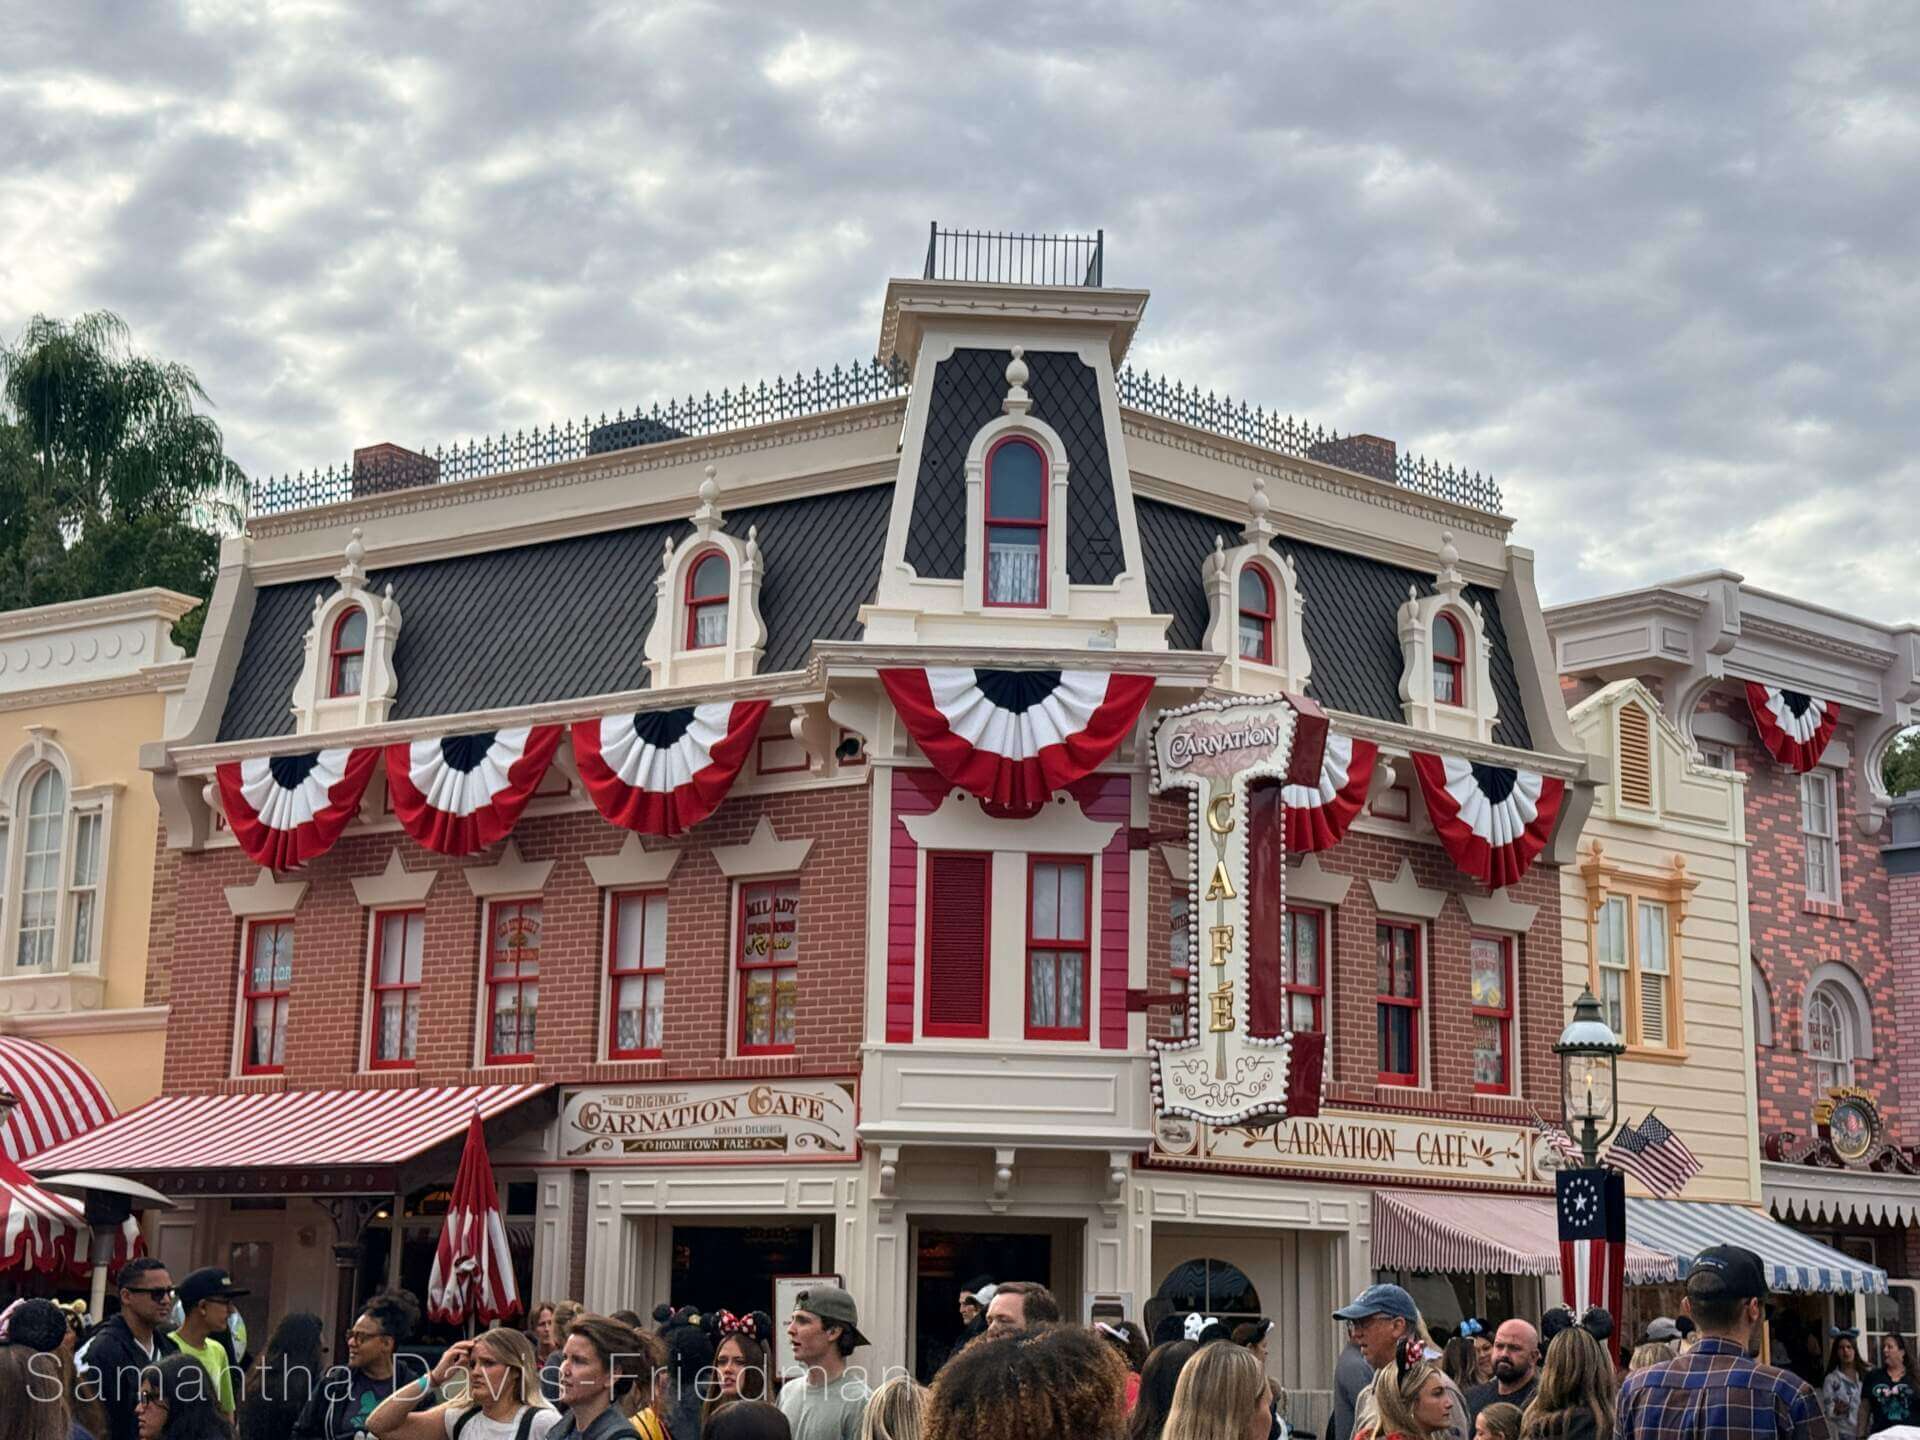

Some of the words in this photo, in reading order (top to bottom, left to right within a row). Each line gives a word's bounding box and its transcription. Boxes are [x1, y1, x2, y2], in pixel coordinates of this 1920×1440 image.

[1166, 725, 1279, 769] CARNATION
[746, 898, 798, 918] MILADY
[1205, 792, 1238, 1034] CAFÉ
[578, 1096, 739, 1134] CARNATION
[607, 1095, 624, 1106] THE
[626, 1093, 681, 1109] ORIGINAL
[655, 1139, 720, 1150] HOMETOWN
[724, 1138, 752, 1149] FARE
[1273, 1119, 1397, 1161] CARNATION
[1416, 1131, 1469, 1168] CAFÉ
